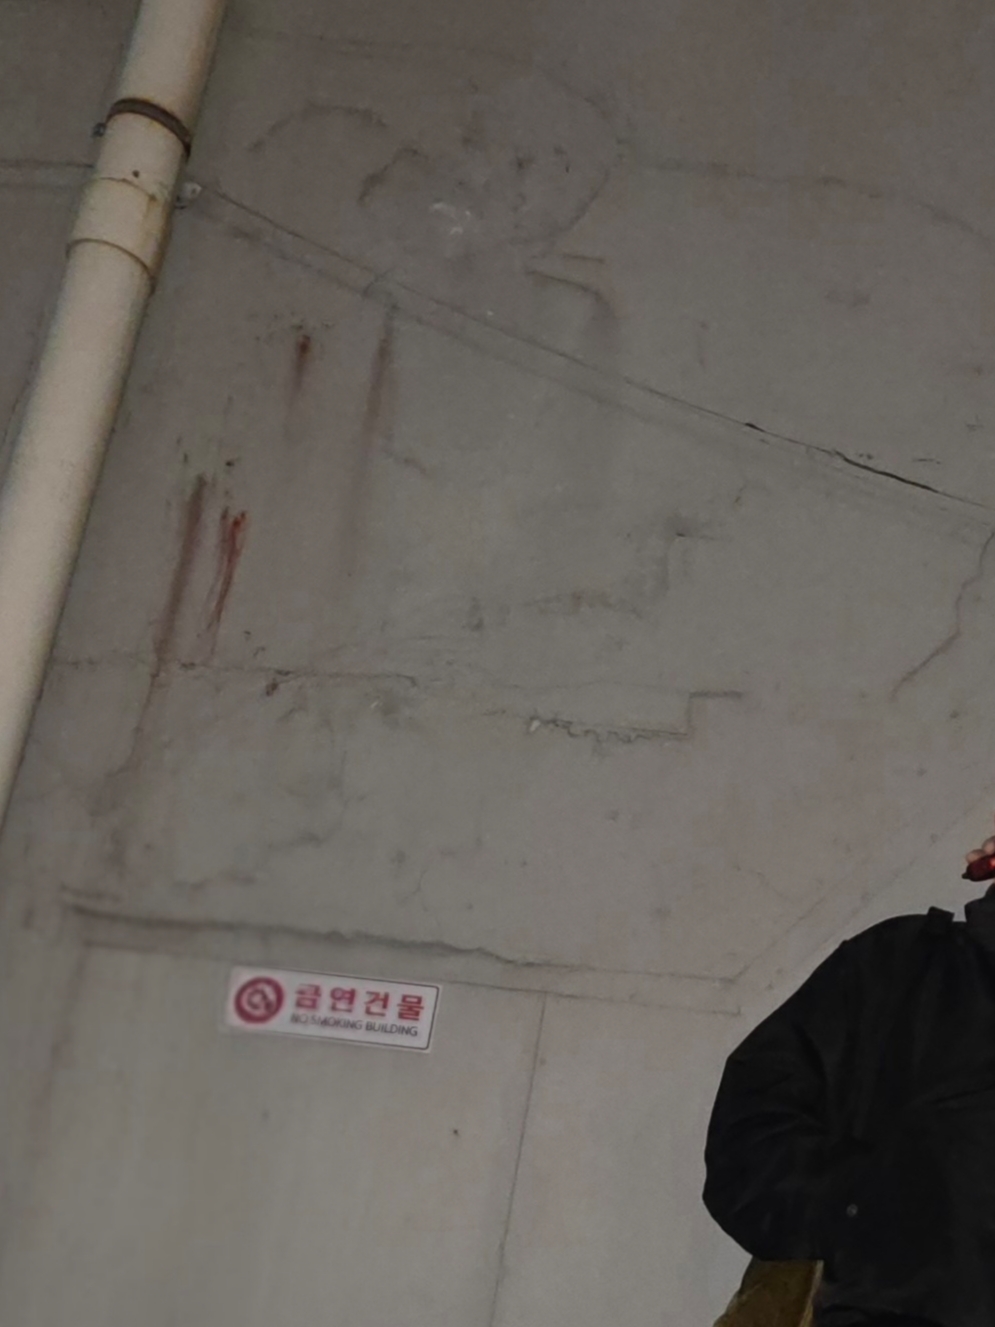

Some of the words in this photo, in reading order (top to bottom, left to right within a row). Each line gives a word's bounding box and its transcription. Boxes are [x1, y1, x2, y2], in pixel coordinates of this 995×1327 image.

[289, 1012, 309, 1025] NO
[310, 1015, 363, 1031] SMOKING
[365, 1021, 419, 1038] BUILDING
